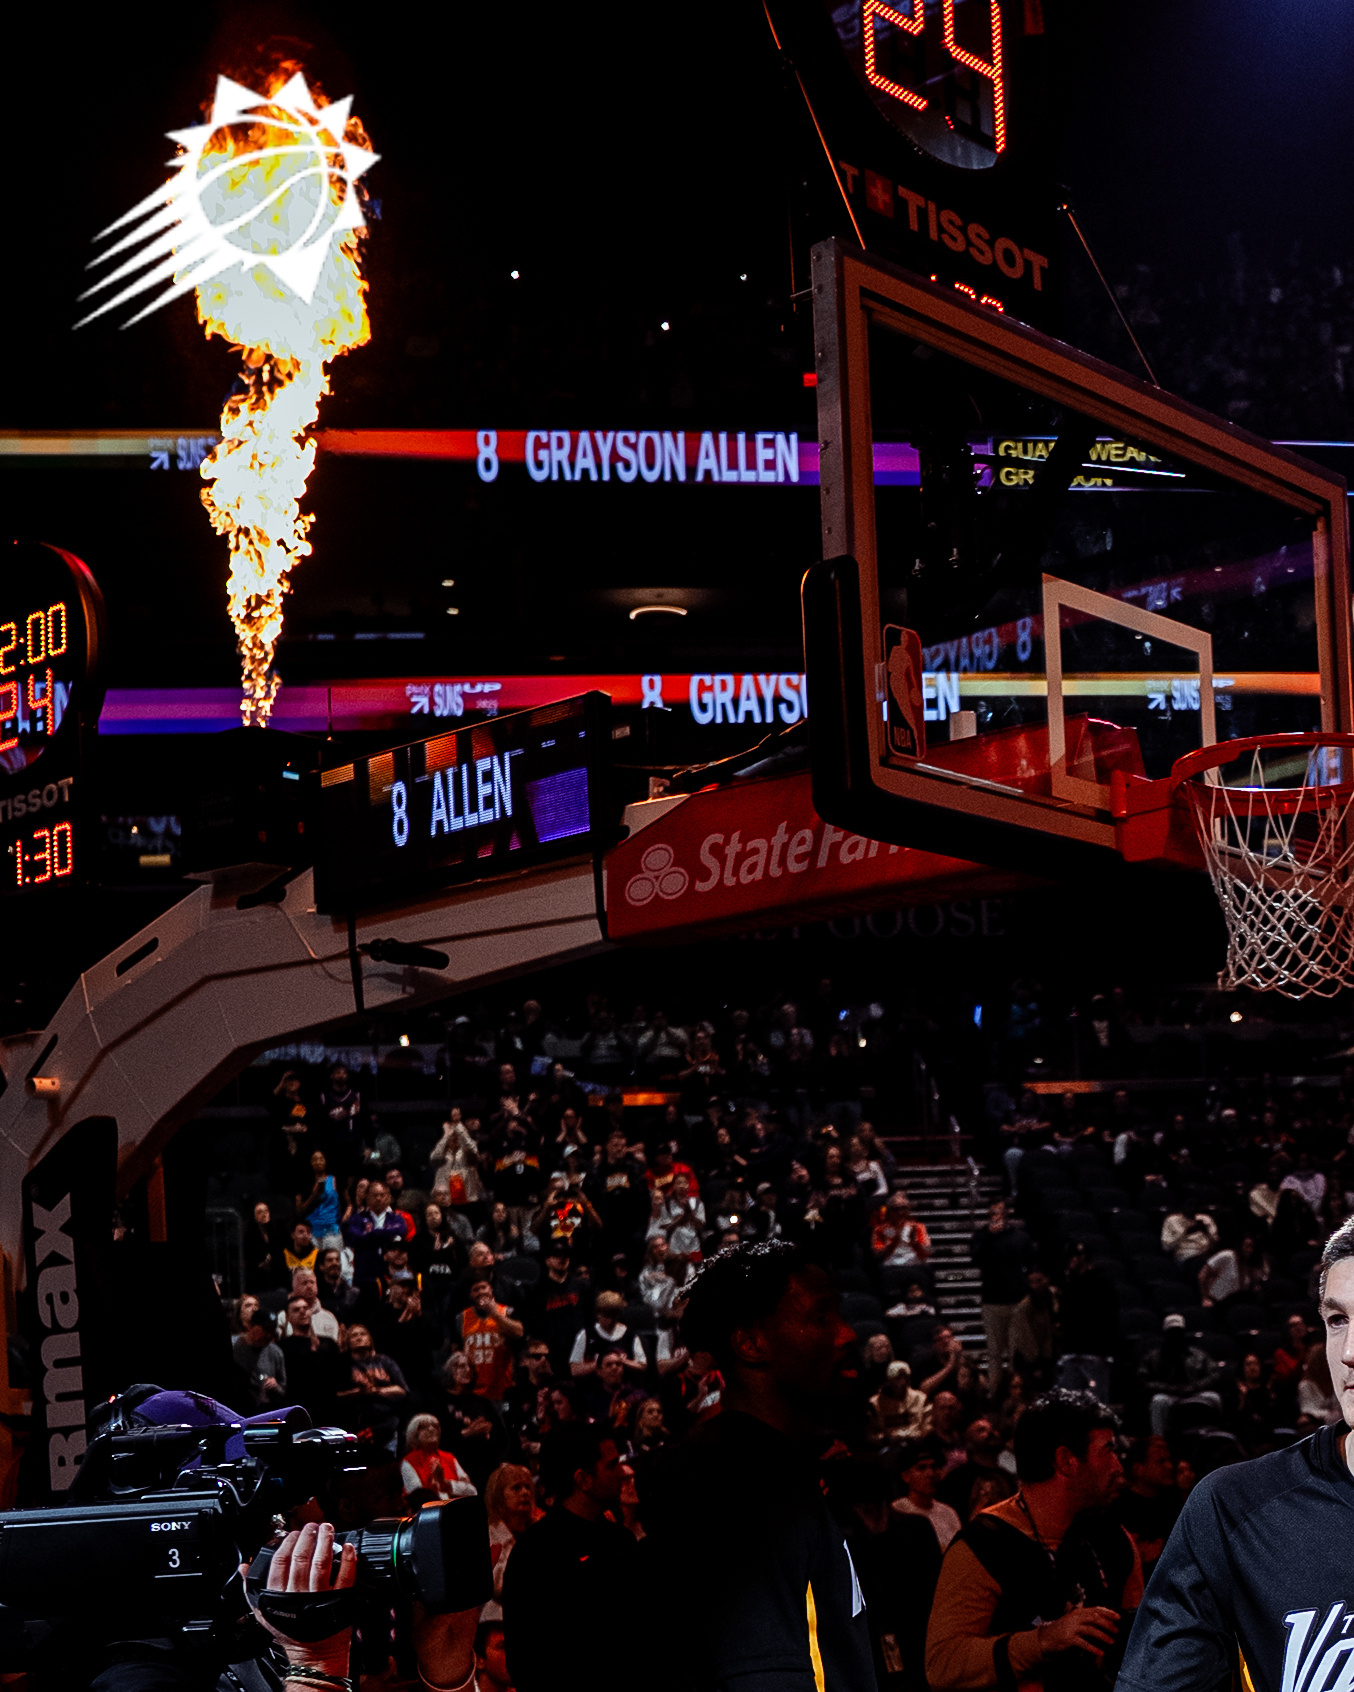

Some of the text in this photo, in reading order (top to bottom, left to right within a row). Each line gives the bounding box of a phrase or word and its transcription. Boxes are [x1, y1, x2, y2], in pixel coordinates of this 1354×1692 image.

[898, 185, 1049, 291] TISSOT
[477, 429, 799, 483] 8 GRAYSON ALLEN
[689, 673, 808, 724] GRAYS
[392, 750, 512, 847] 8 ALLEN
[16, 822, 73, 886] 1:30
[150, 1520, 192, 1532] SONY
[168, 1549, 180, 1568] 3
